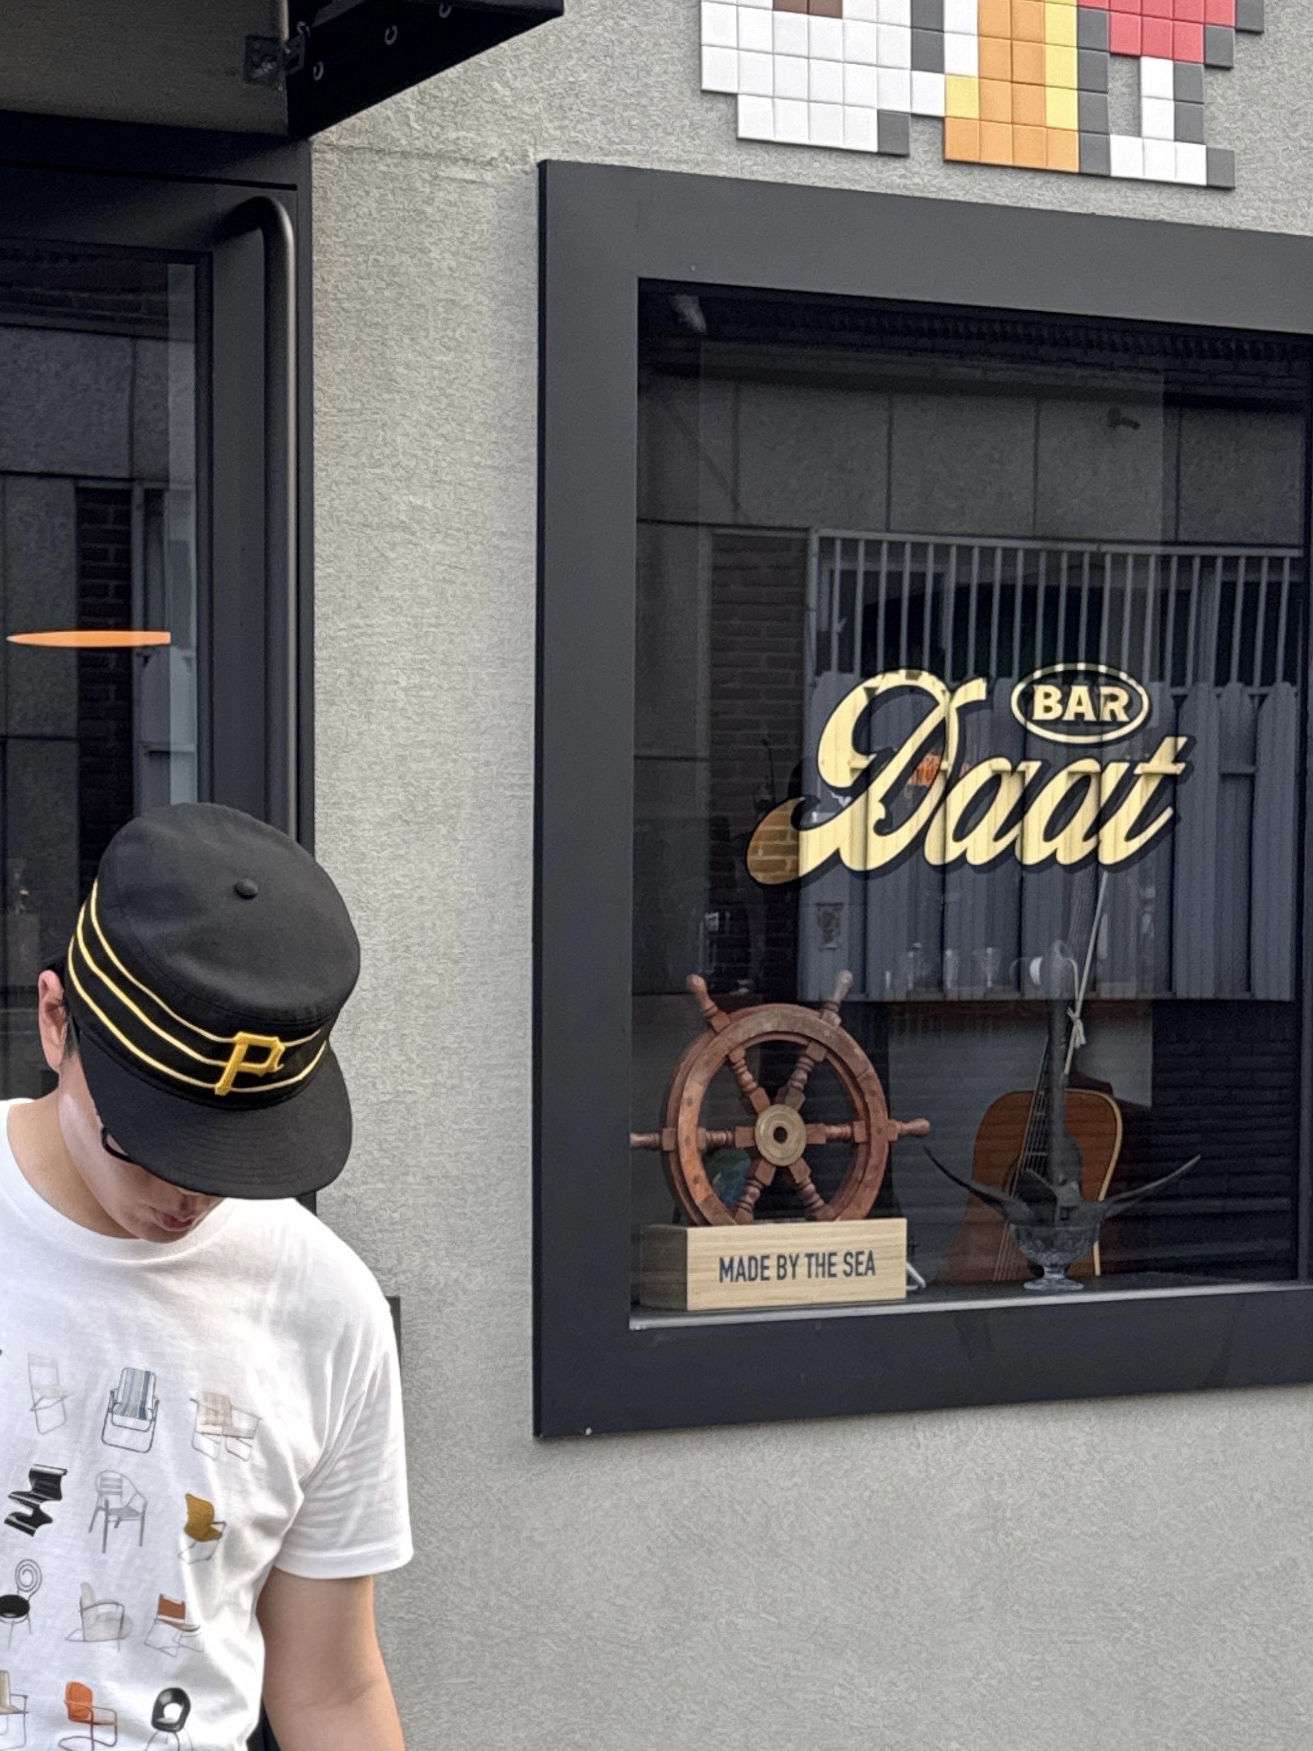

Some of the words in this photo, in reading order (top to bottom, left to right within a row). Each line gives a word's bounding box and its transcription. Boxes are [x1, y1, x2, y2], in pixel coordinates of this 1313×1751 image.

[1031, 683, 1129, 722] BAR
[214, 1031, 285, 1096] P
[719, 1255, 770, 1283] MADE
[776, 1253, 800, 1280] BY
[805, 1252, 837, 1279] THE
[843, 1250, 876, 1277] SEA
